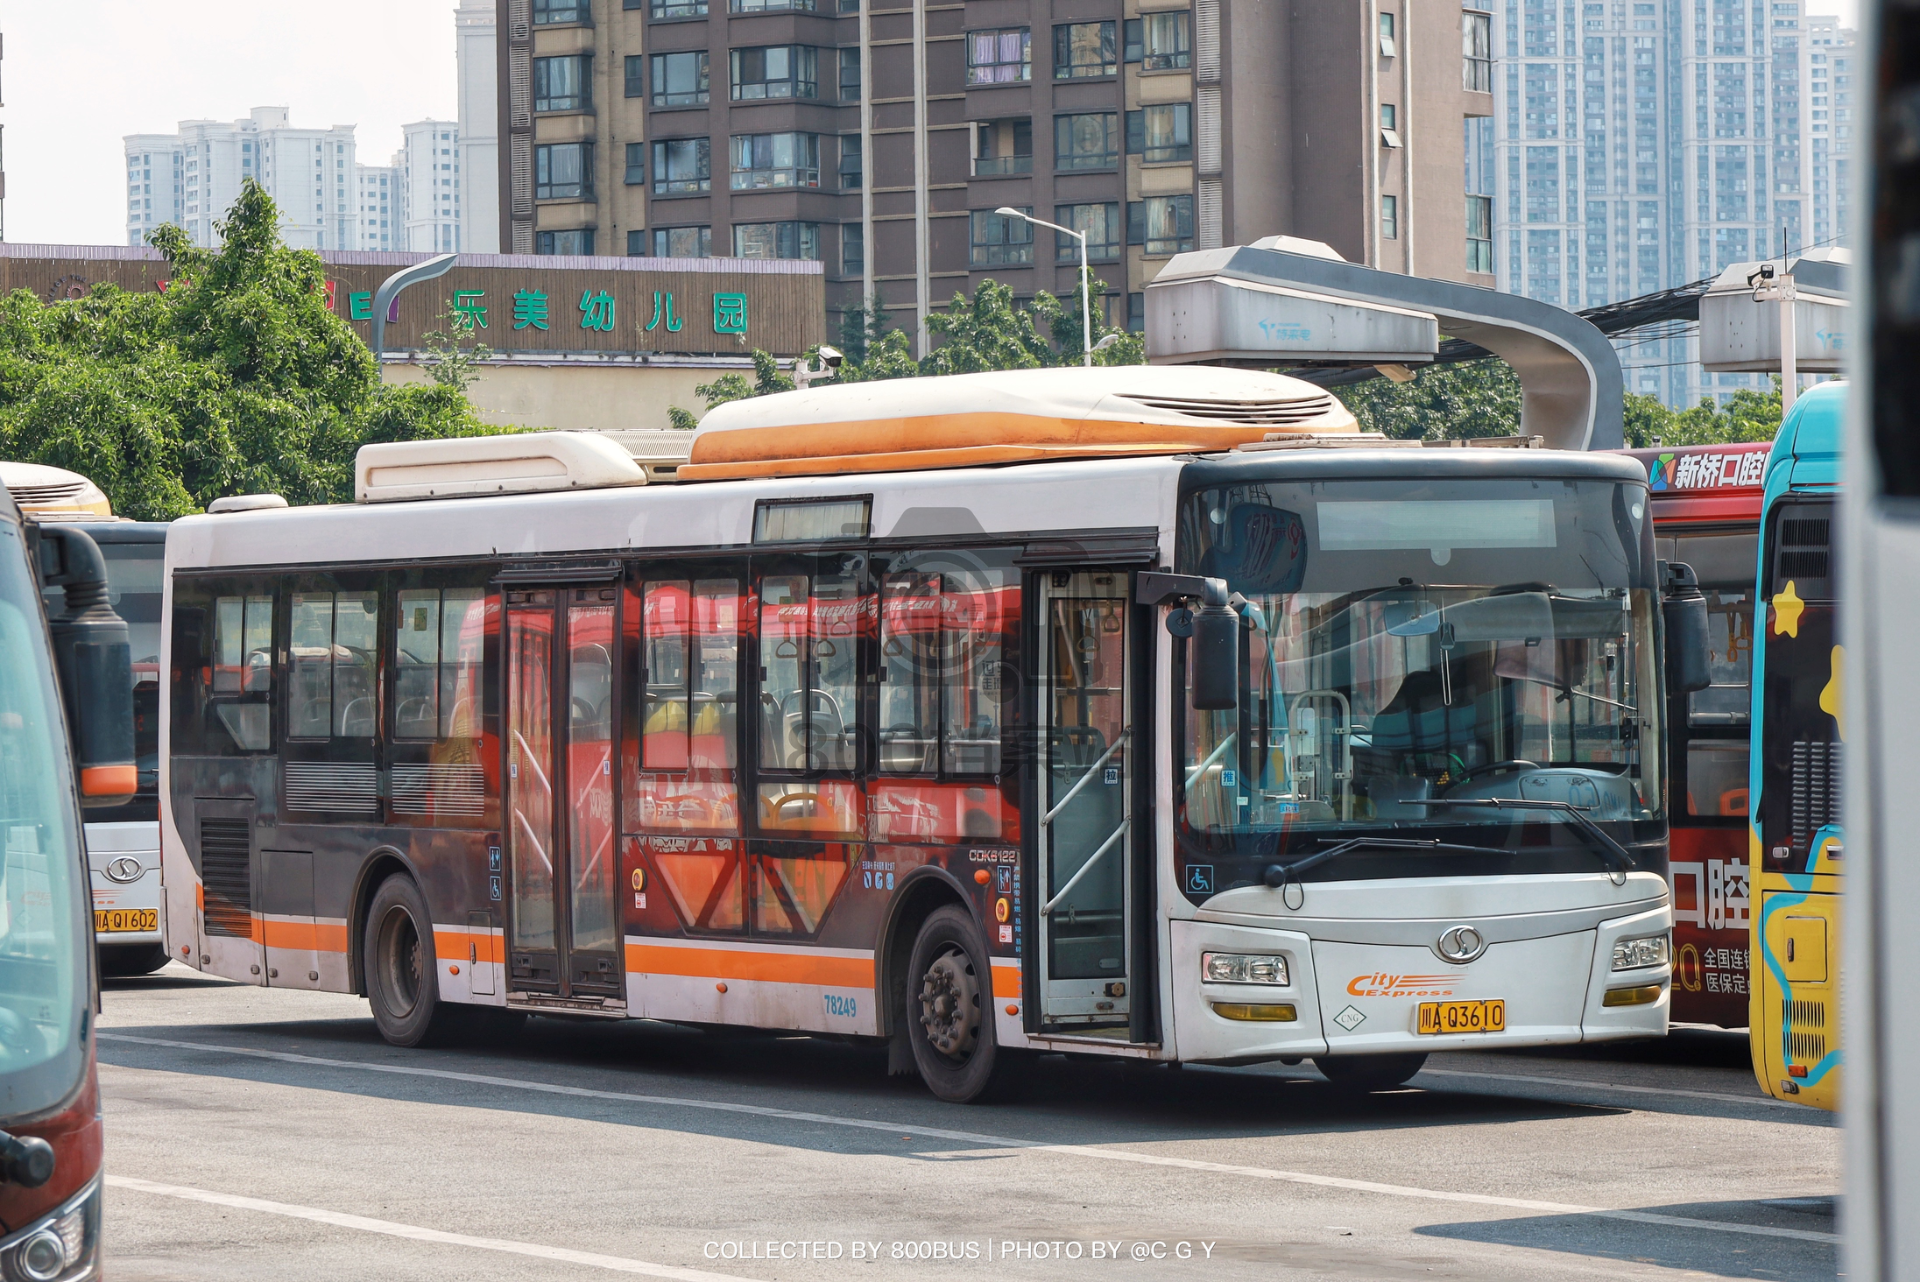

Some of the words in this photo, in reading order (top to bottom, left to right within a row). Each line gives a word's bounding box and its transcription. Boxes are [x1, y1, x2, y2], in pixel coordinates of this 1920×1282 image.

[453, 288, 748, 333] 乐美幼儿园
[1669, 858, 1749, 930] 口腔
[1347, 972, 1400, 997] City
[824, 994, 857, 1018] 78249
[1341, 1014, 1359, 1023] CNG
